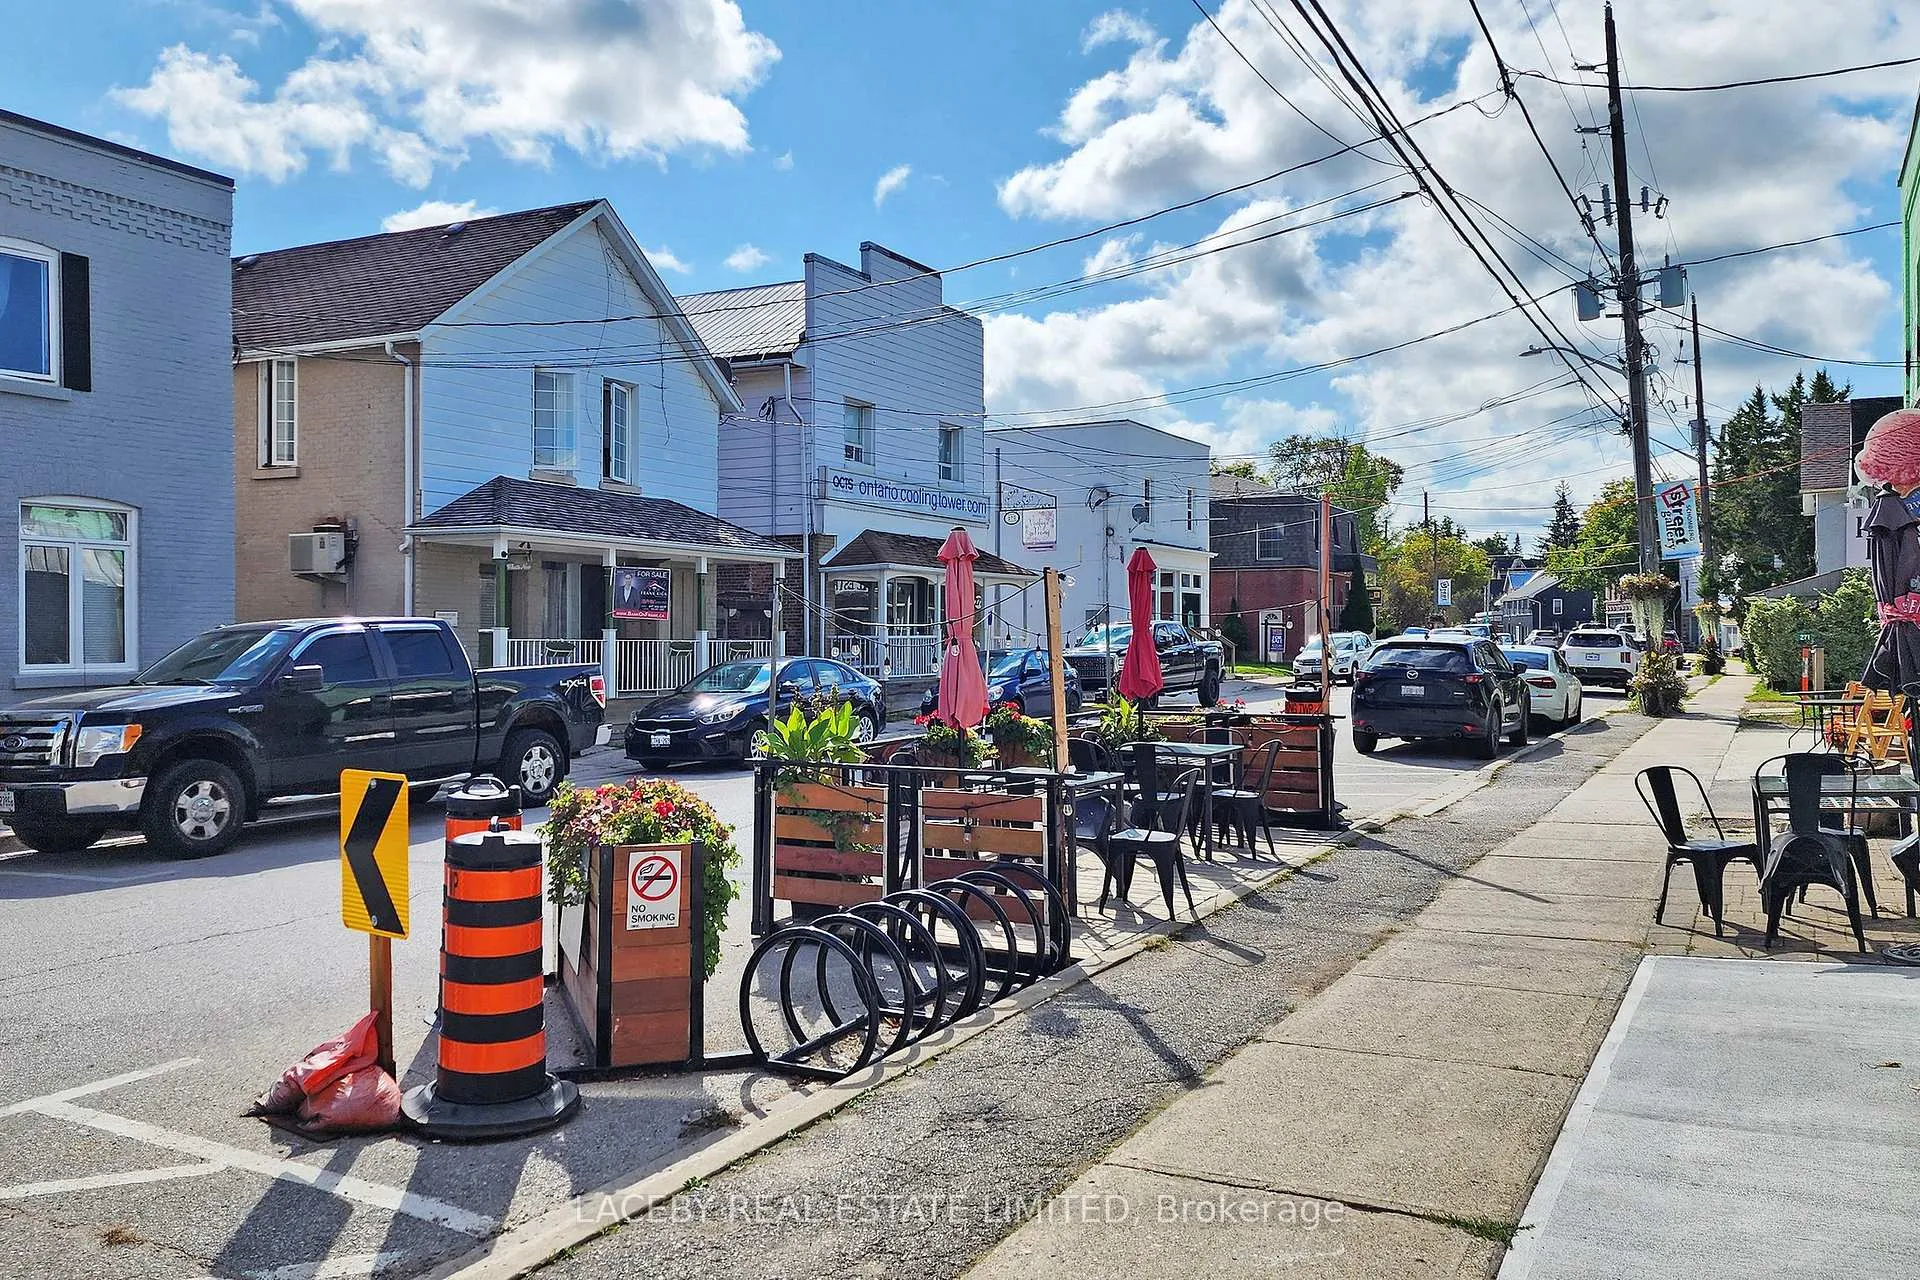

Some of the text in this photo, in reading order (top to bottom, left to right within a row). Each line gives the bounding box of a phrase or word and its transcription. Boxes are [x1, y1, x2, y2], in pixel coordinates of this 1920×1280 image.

[1660, 510, 1676, 550] gallery
[1670, 491, 1690, 545] street
[1685, 504, 1696, 542] SCHOMBERG
[637, 570, 668, 579] FOR SALE
[631, 904, 646, 913] NO
[631, 912, 676, 924] SMOKING
